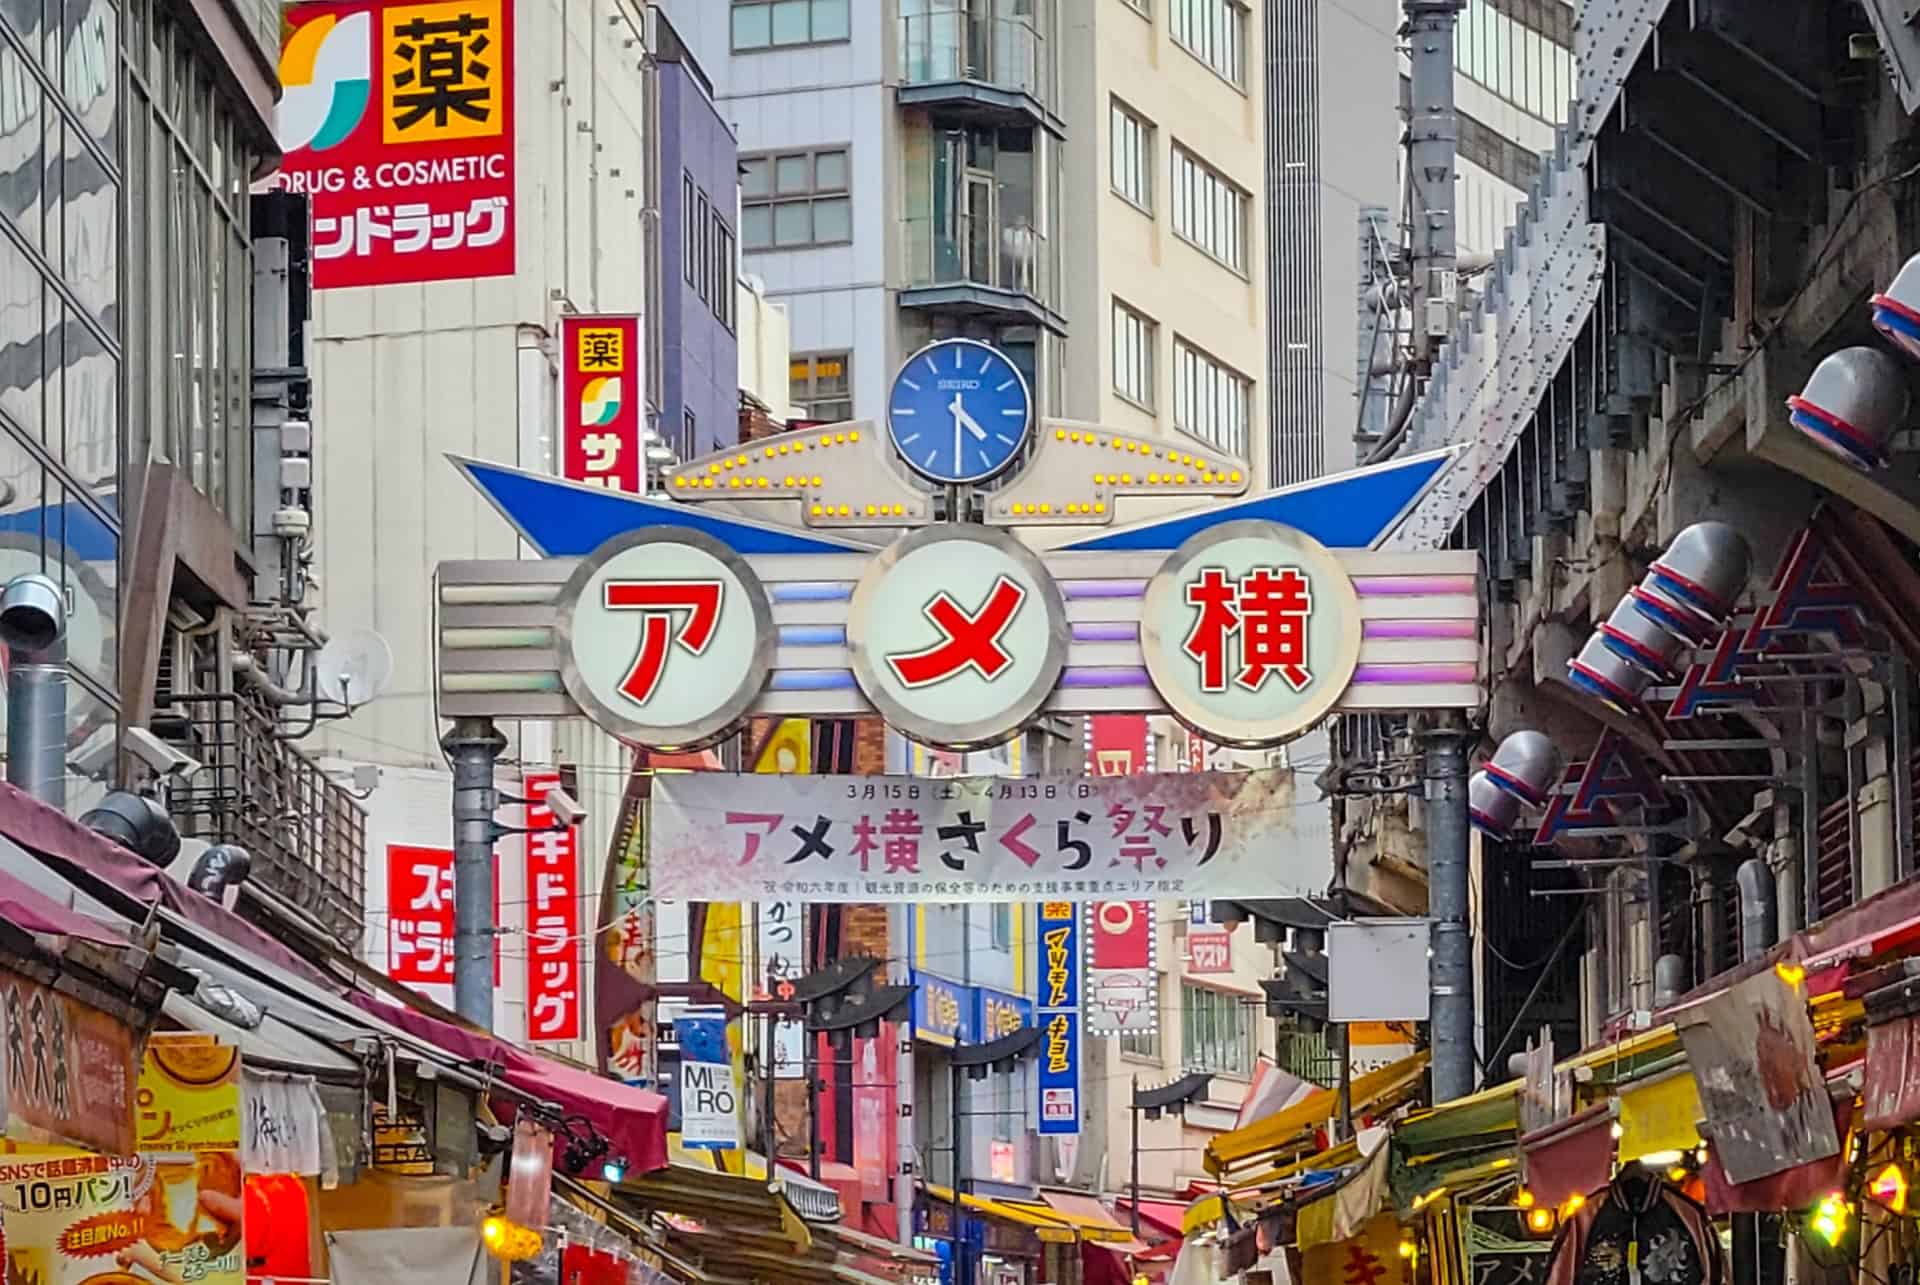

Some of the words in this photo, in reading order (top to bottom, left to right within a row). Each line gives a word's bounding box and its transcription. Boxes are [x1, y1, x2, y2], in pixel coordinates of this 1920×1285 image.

[392, 13, 490, 131] 薬
[352, 165, 371, 188] &
[380, 153, 505, 188] COSMETIC
[584, 332, 620, 367] 薬
[937, 379, 980, 390] SEIKO
[725, 803, 1223, 874] アメ横さくら祭り
